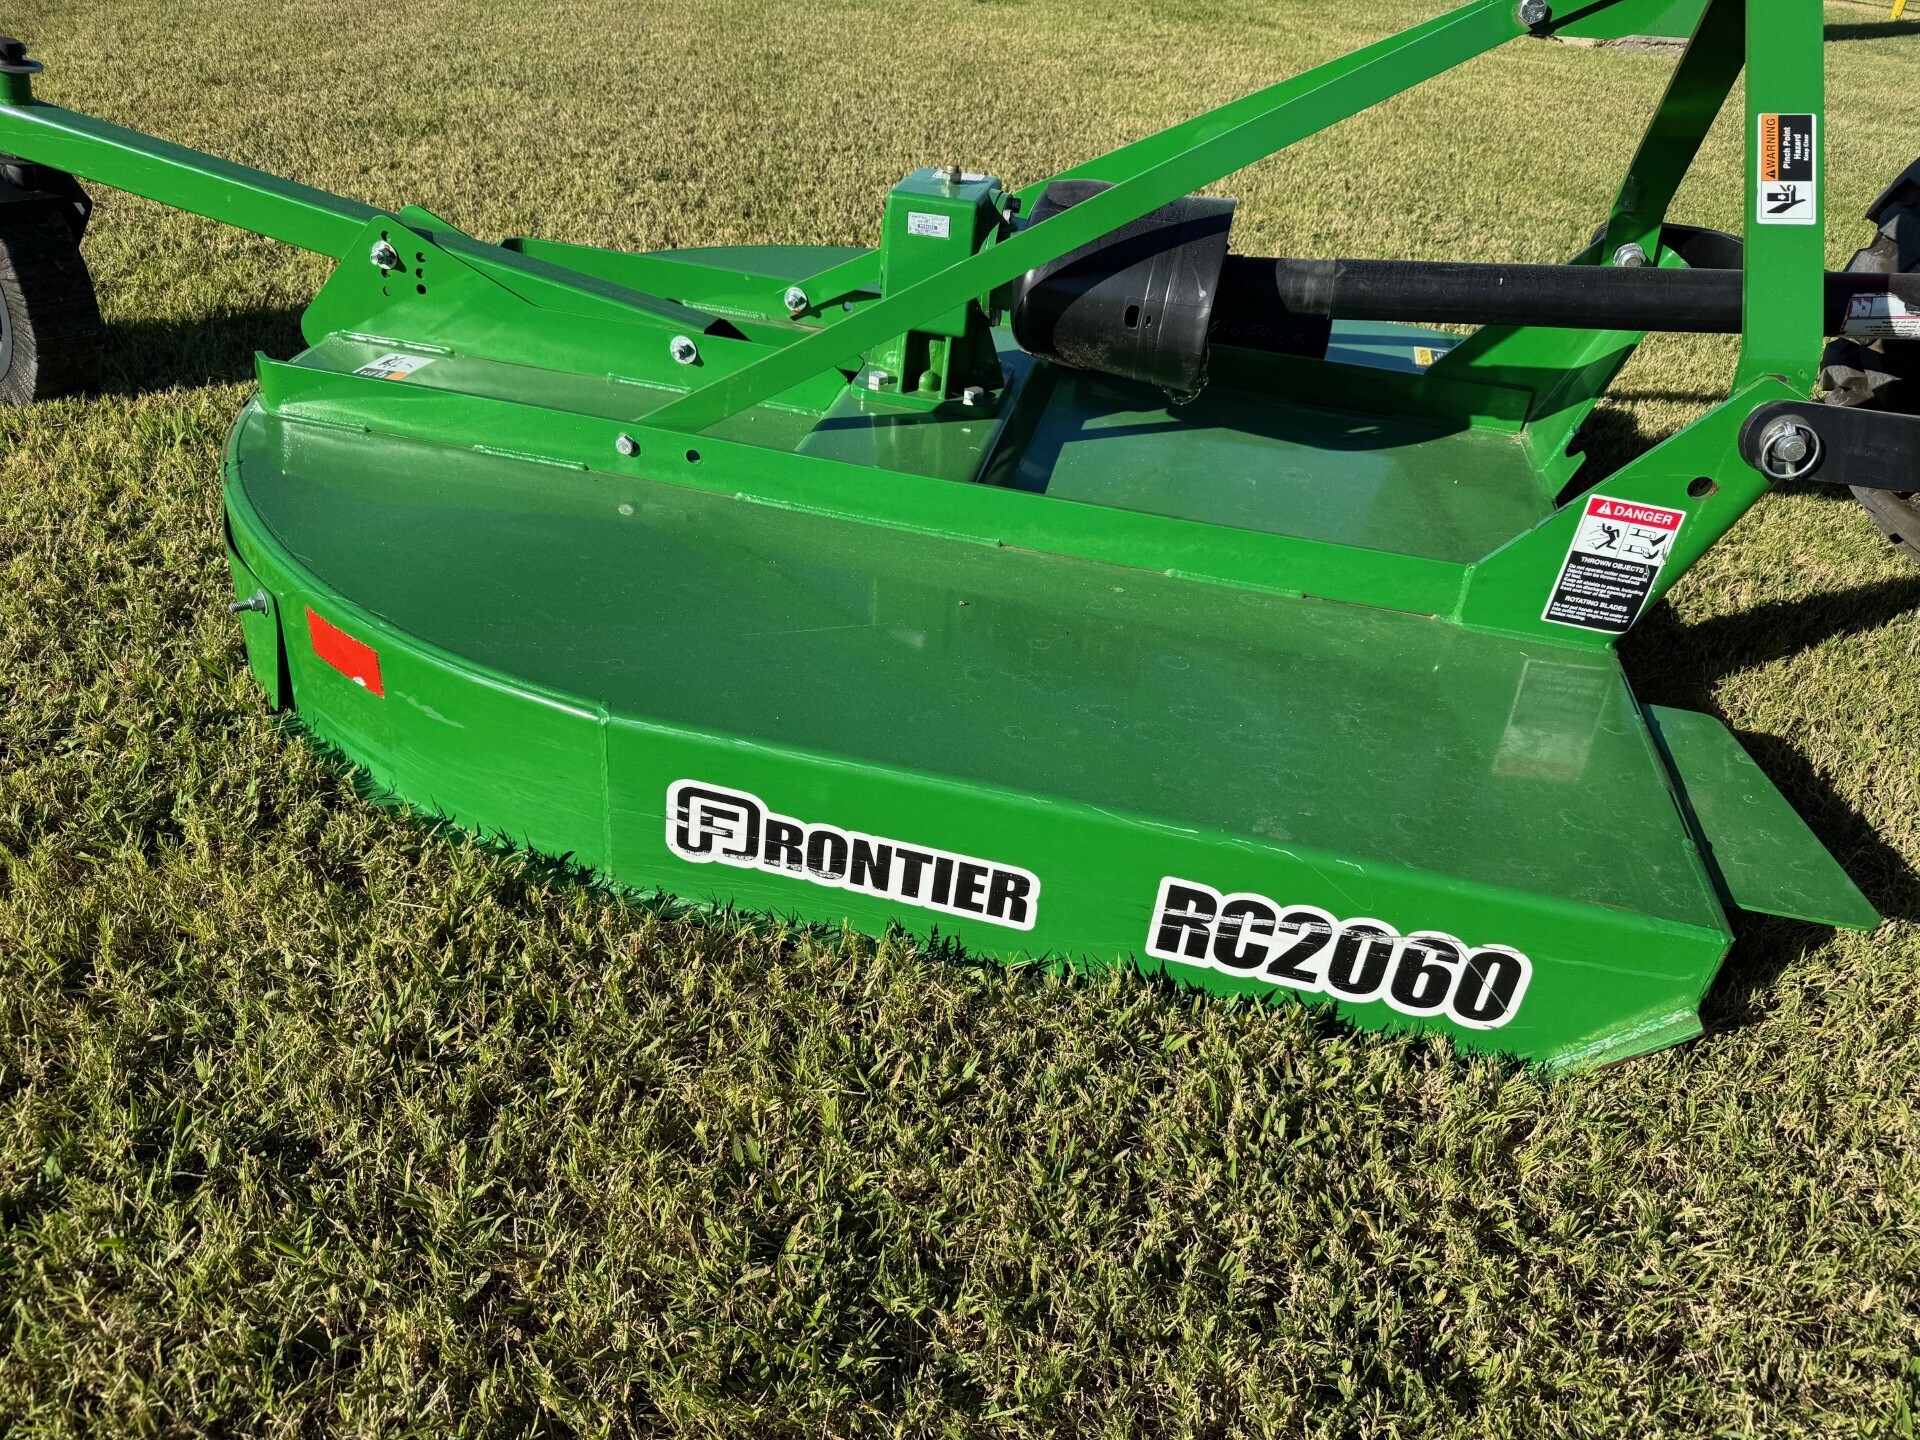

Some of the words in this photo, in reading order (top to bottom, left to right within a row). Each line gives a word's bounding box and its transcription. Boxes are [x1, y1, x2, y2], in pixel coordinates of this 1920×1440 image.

[1766, 118, 1776, 169] WARNING
[1783, 126, 1791, 146] Point
[1794, 133, 1802, 160] Hazard
[1783, 147, 1791, 169] Pinch
[1614, 506, 1673, 525] DANGER
[1581, 556, 1612, 566] THROWN
[1611, 562, 1645, 573] OBJECTS
[1620, 587, 1644, 596] including
[1564, 595, 1599, 606] ROTATING
[1599, 602, 1628, 612] BLADES
[677, 786, 1030, 923] FRONTIER
[1156, 884, 1522, 1021] RC2060
